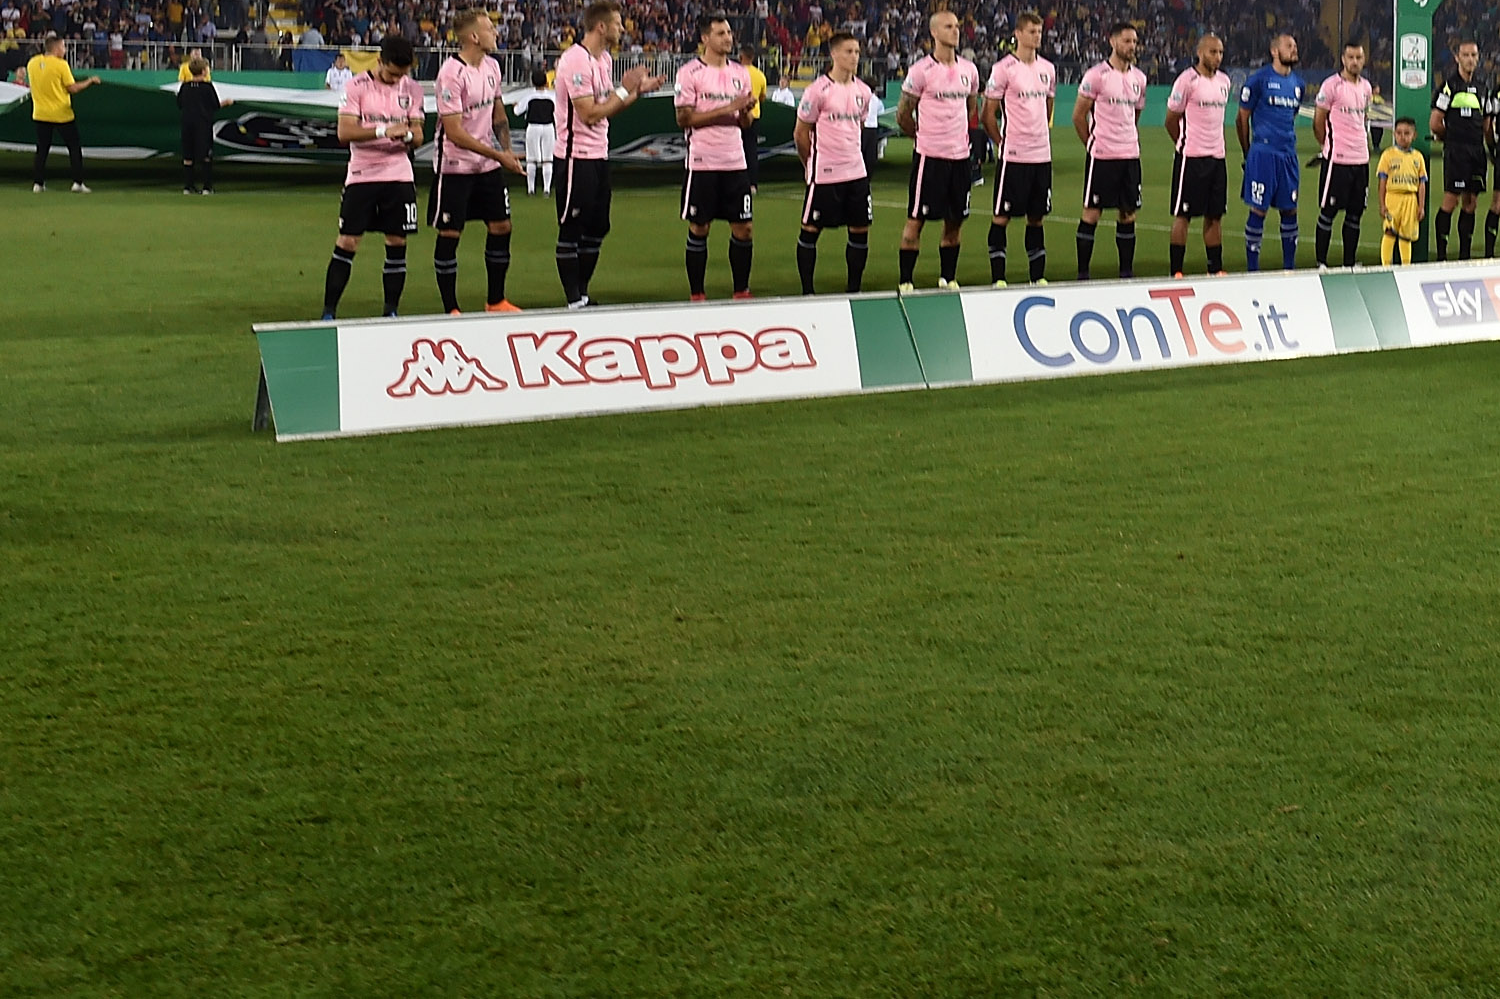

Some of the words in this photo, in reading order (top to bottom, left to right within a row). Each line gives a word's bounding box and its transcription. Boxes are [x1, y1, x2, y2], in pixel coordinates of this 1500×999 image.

[404, 202, 418, 224] 10
[1431, 281, 1484, 322] sky
[1013, 288, 1300, 368] ConTe.it
[507, 328, 818, 389] Kappa
